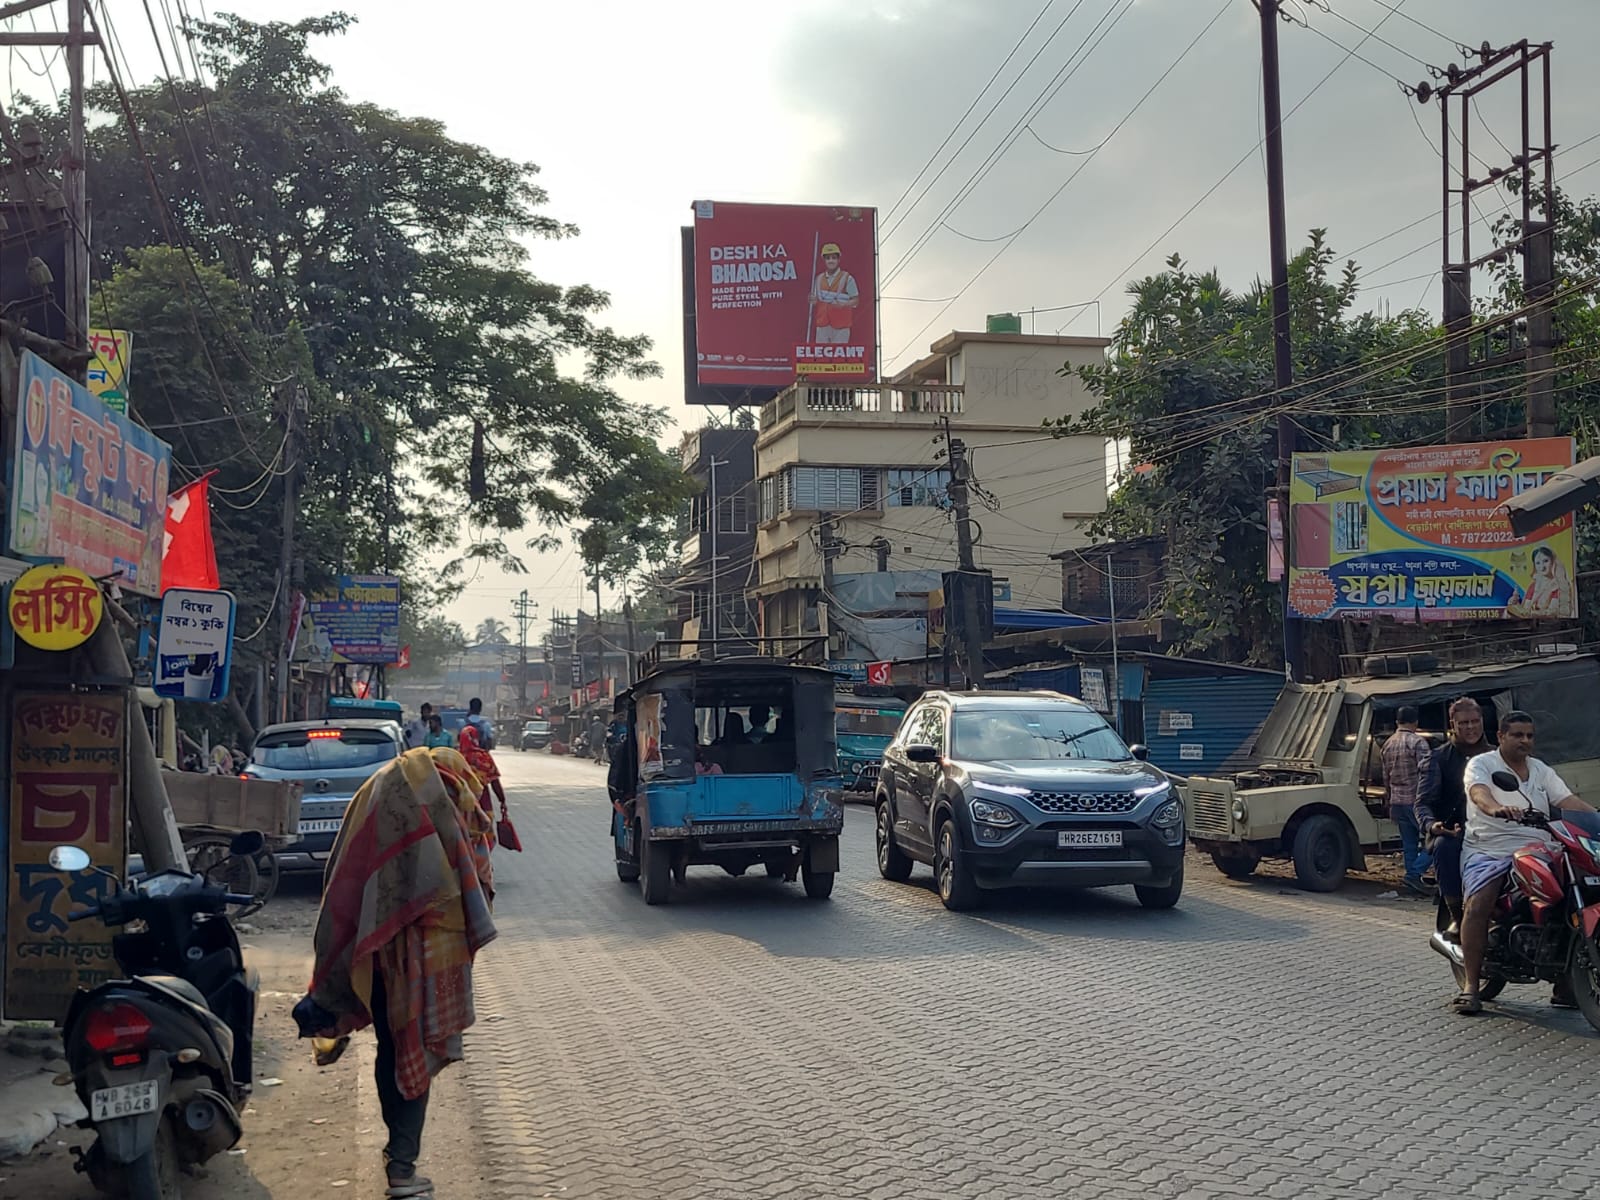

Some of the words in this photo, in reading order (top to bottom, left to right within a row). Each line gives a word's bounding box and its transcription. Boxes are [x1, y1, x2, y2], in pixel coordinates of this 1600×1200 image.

[710, 245, 758, 261] DESH
[762, 243, 788, 259] KA
[711, 260, 797, 284] BHAROSA
[711, 286, 735, 295] MADE
[736, 285, 759, 293] FROM
[711, 294, 734, 302] PURE
[735, 292, 760, 301] STEEL
[761, 291, 783, 299] WITH
[711, 300, 762, 309] PERFECTION
[796, 346, 865, 358] ELEGANT
[125, 441, 156, 504] ঘর
[1376, 472, 1448, 507] প্রয়াস
[1441, 534, 1451, 545] M
[1461, 531, 1527, 544] 78722022
[1338, 573, 1408, 605] স্বপ্না
[1413, 567, 1498, 607] জুয়েলার্স
[13, 575, 98, 635] লস্যি
[181, 599, 214, 614] বিশ্বের
[166, 615, 190, 628] নম্বর
[200, 617, 225, 631] কুকি
[74, 746, 121, 766] মানের
[16, 772, 120, 843] চা
[1064, 833, 1121, 844] HR26EZ1613
[114, 1097, 151, 1114] 6048
